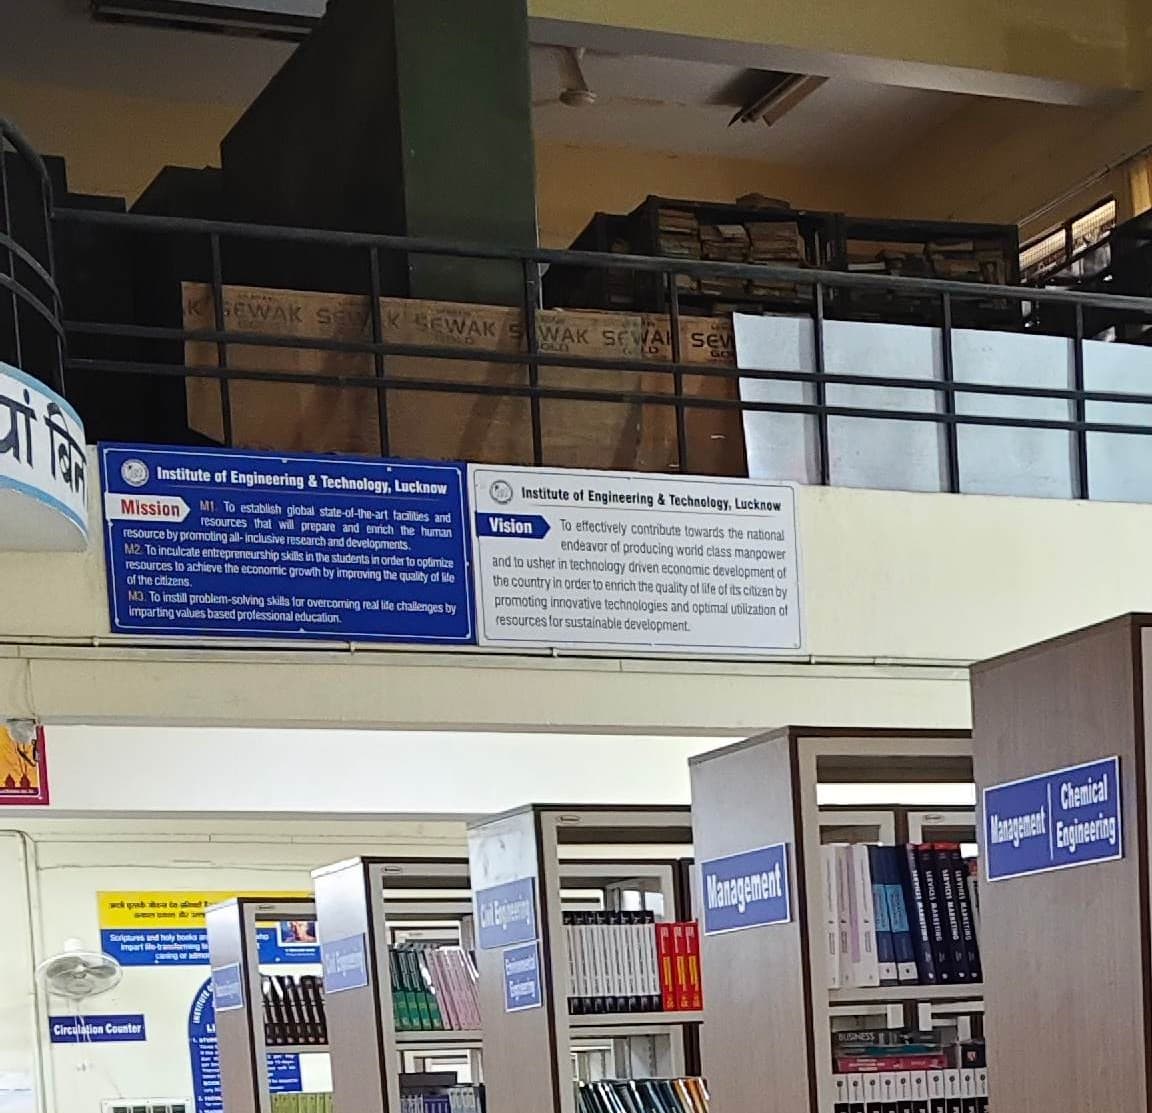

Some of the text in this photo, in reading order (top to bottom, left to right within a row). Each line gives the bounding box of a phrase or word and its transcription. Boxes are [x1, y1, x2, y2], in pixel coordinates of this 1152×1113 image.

[157, 466, 447, 494] Institute of Engineering & Technology, Lucknow
[121, 499, 179, 516] Mission
[521, 486, 780, 511] Institute of Engineering & Technology, Lucknow
[223, 500, 235, 512] To
[240, 503, 281, 514] establish
[286, 504, 314, 517] global
[319, 506, 387, 520] state-of-the-art
[434, 512, 451, 523] and
[200, 516, 452, 537] resources that will prepare and enrich the human
[489, 517, 532, 533] Vision
[559, 518, 784, 541] To effectively contribute towards the national
[123, 528, 165, 539] resource
[179, 530, 227, 544] promoting
[244, 532, 285, 544] inclusive
[286, 536, 326, 546] research
[327, 537, 344, 547] and
[144, 544, 156, 555] To
[158, 545, 200, 557] inculcate
[202, 547, 279, 562] entrepreneurship
[280, 550, 304, 561] skills
[315, 552, 329, 562] the
[331, 553, 369, 564] students
[380, 555, 404, 566] order
[560, 538, 785, 560] endeavor of producing world class manpower
[125, 560, 439, 584] resources achieve the economic growth improving the quality of
[492, 555, 785, 580] and usher technology driven economic development of
[126, 574, 136, 584] of
[137, 574, 152, 585] the
[492, 574, 727, 596] the country order enrich the quality of of
[128, 605, 174, 619] imparting
[175, 607, 206, 618] values
[206, 607, 235, 619] based
[237, 609, 293, 621] professional
[148, 590, 443, 614] To instill problem-solving skills overcoming challenges
[494, 594, 547, 610] promoting
[550, 596, 601, 609] innovative
[604, 598, 667, 614] technologies
[670, 600, 689, 613] and
[778, 604, 787, 616] of
[495, 615, 547, 627] resources
[564, 616, 622, 629] sustainable
[1060, 773, 1108, 811] Chemical
[990, 804, 1046, 848] Management
[1056, 814, 1116, 854] Engineering
[706, 862, 783, 913] Management
[54, 1022, 142, 1036] Circulation Counter
